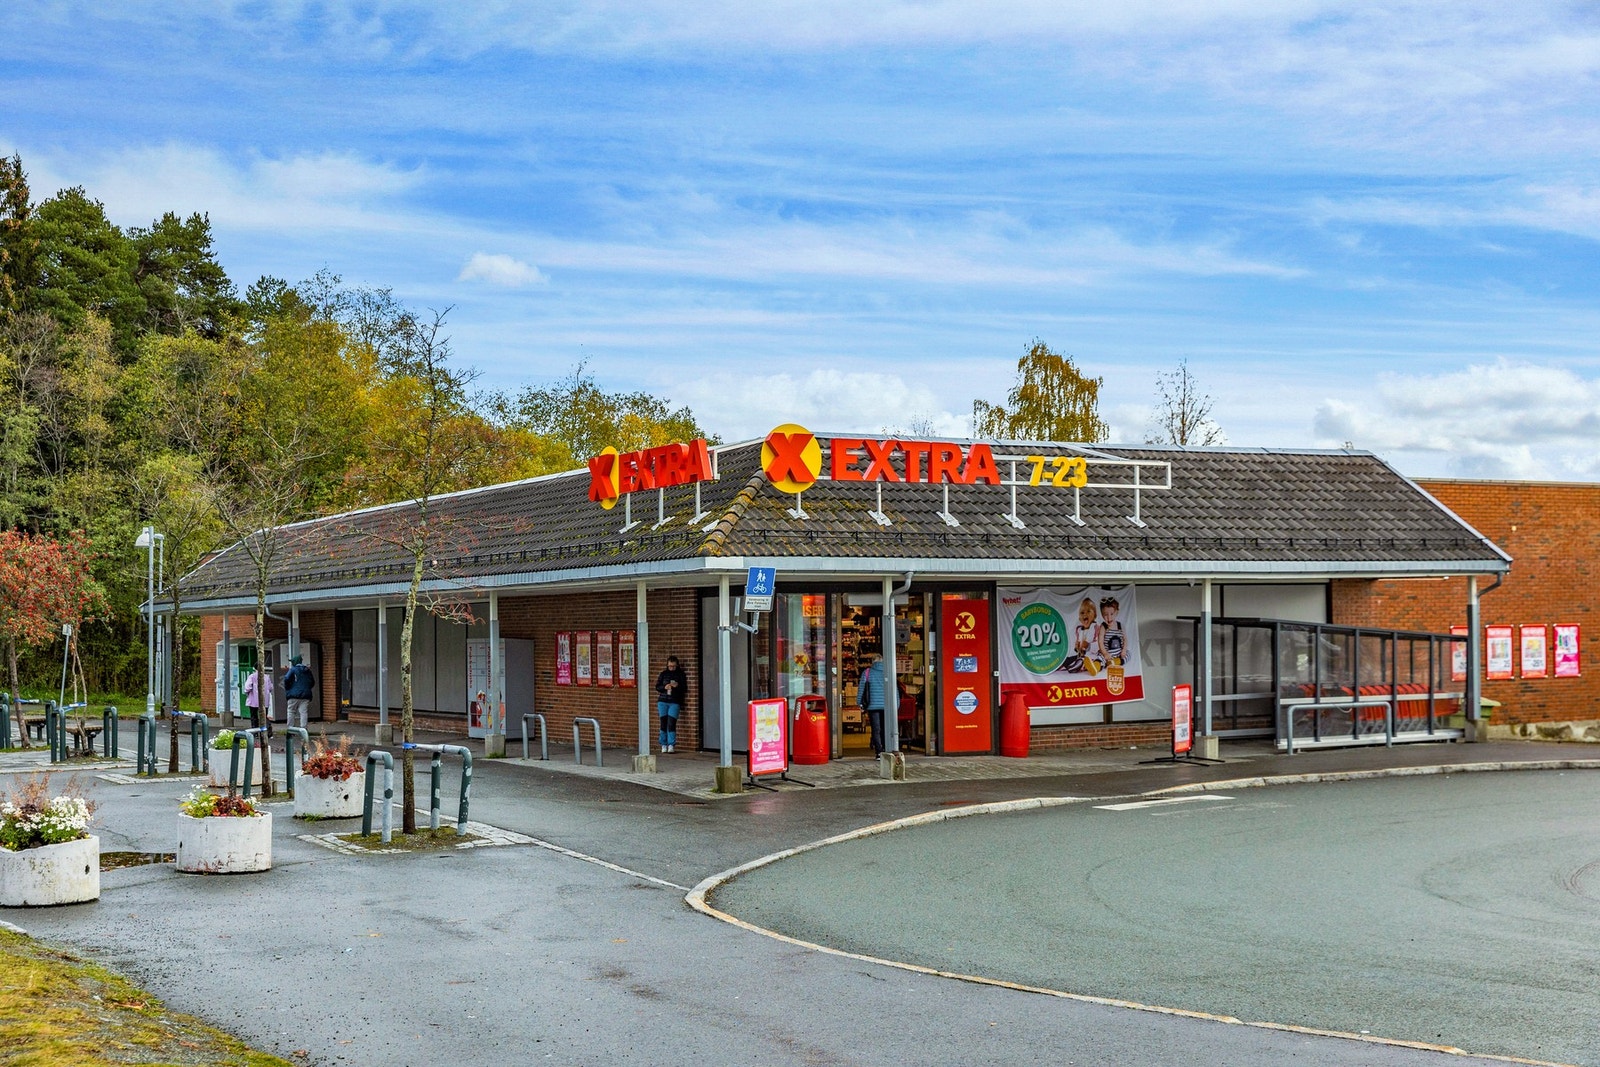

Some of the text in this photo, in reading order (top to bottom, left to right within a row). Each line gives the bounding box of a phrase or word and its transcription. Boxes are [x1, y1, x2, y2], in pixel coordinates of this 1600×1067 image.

[588, 438, 713, 503] X EXTRA
[765, 432, 1088, 488] X EXTRA 7-23
[1017, 622, 1060, 647] 20%
[1064, 686, 1098, 699] EXTRA
